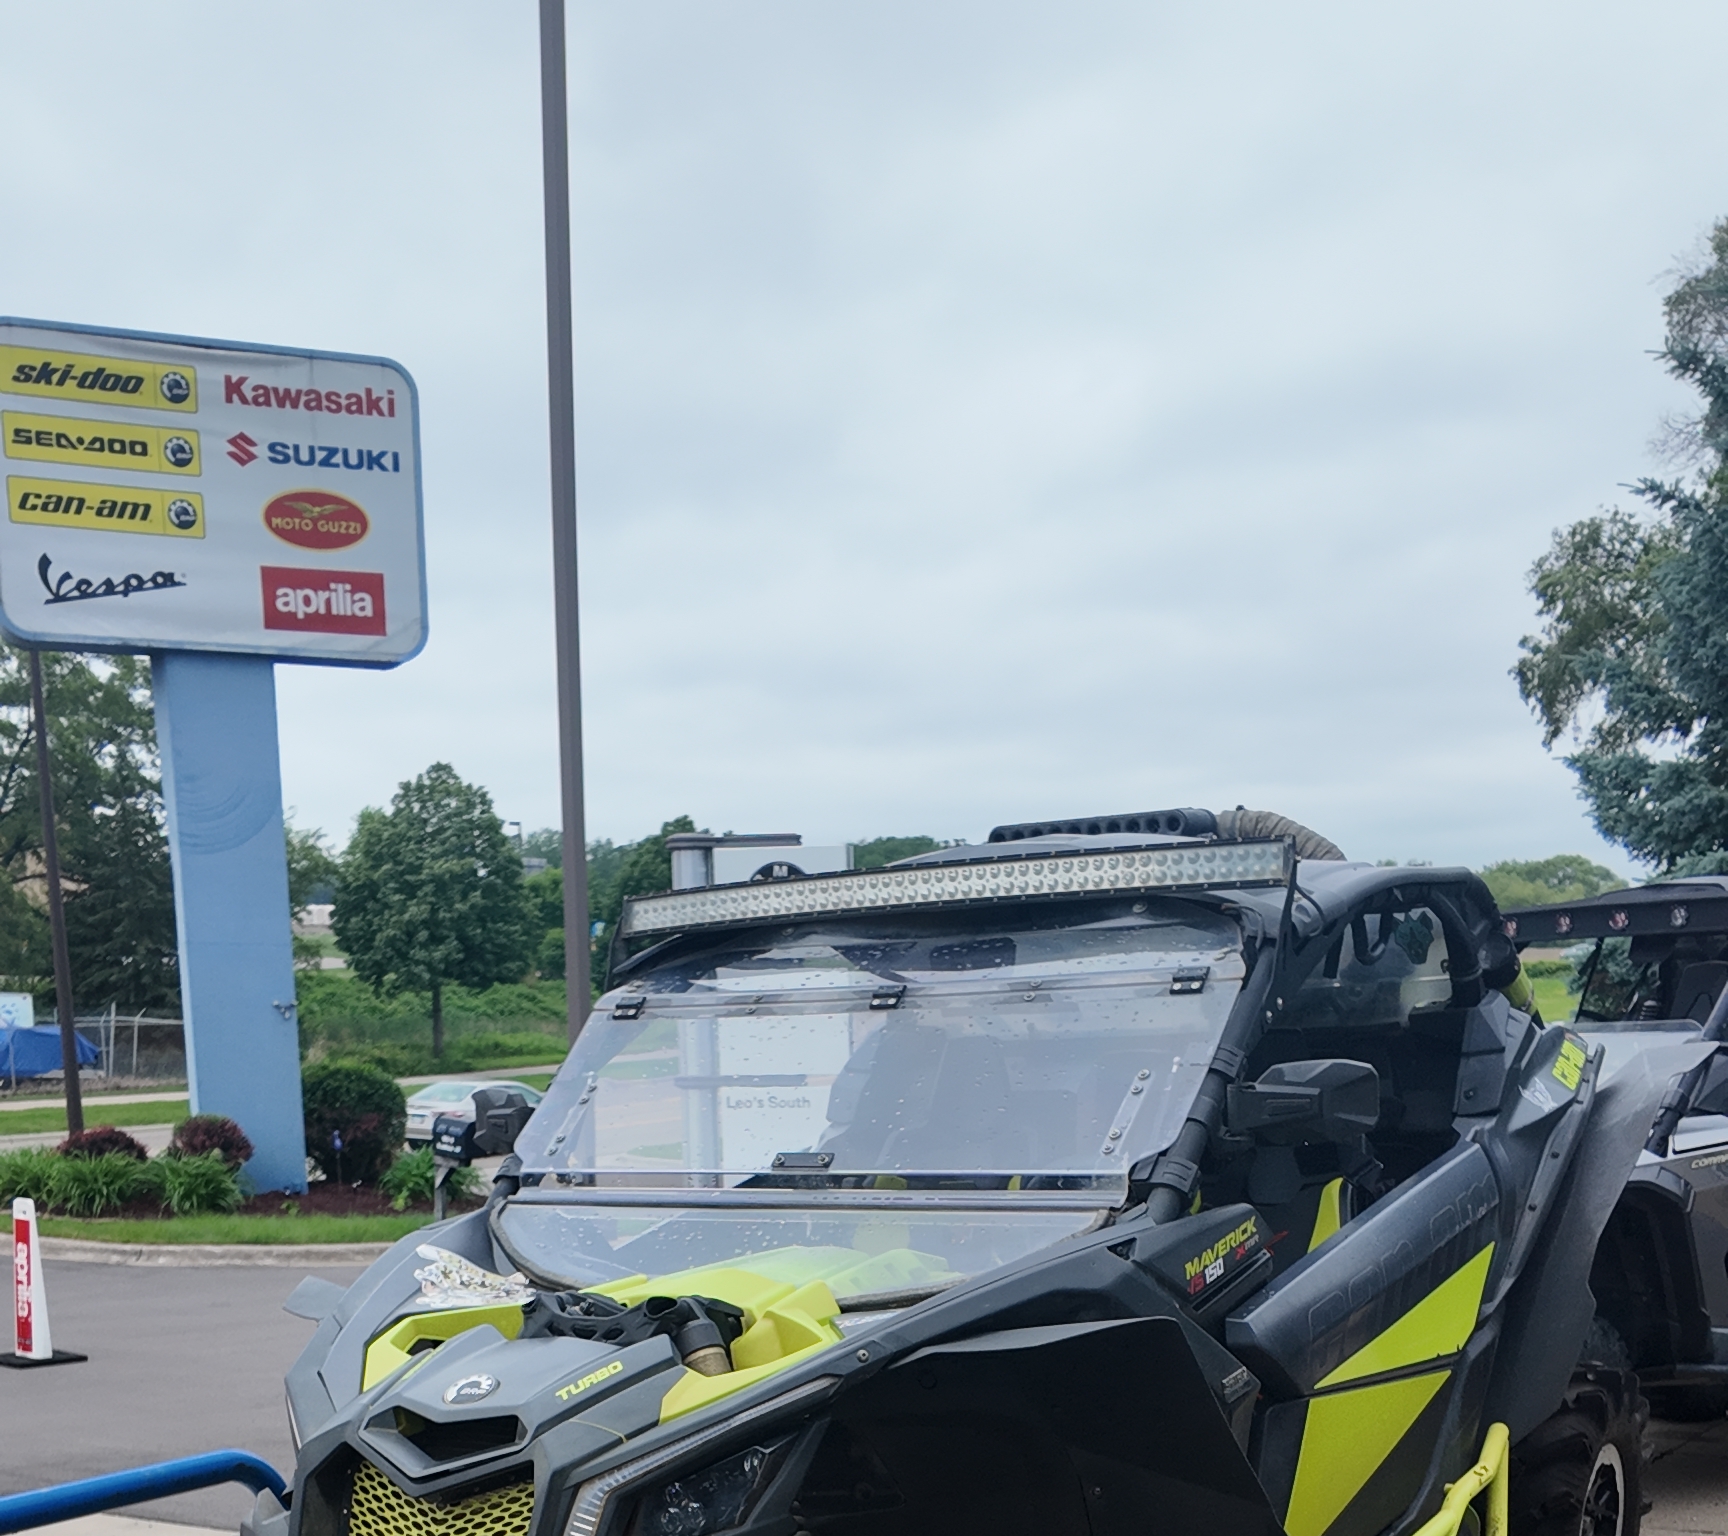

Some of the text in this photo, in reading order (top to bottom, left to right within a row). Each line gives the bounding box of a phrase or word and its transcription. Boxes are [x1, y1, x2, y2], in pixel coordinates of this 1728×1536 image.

[224, 374, 396, 418] Kawasaki
[267, 441, 400, 473] SUZUKI
[271, 516, 361, 535] MOTO GUZZI
[38, 552, 187, 605] Vespa
[275, 582, 374, 619] aprilia
[726, 1095, 811, 1109] Leo's South
[1184, 1215, 1257, 1280] MAVERICK
[555, 1360, 623, 1401] TURBO
